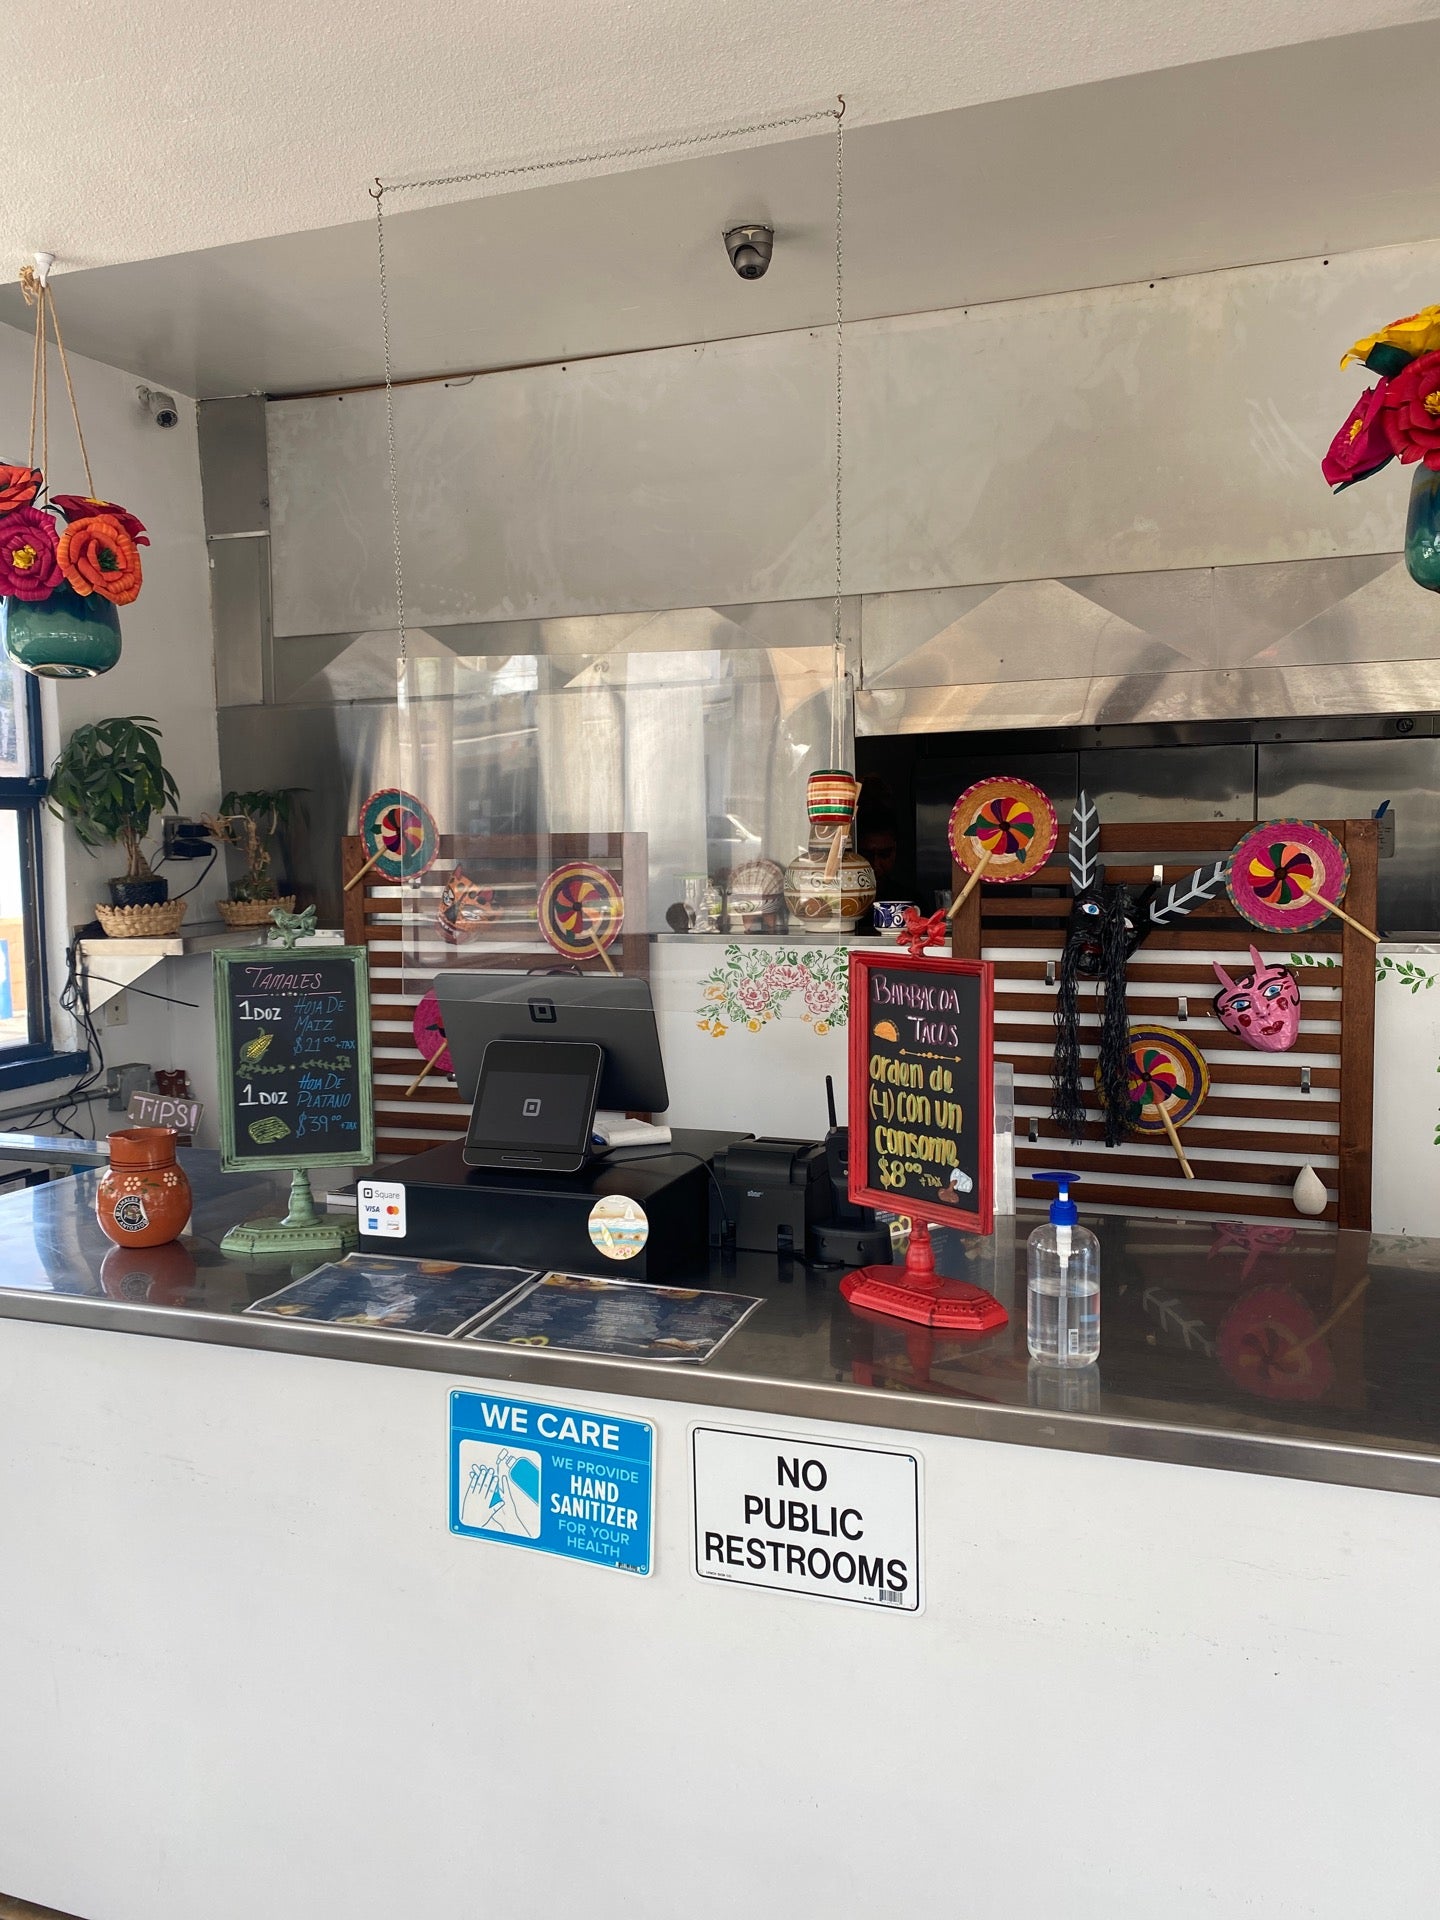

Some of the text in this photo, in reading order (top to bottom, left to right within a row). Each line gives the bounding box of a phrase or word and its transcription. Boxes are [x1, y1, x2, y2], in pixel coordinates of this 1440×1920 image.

[245, 966, 322, 989] TAMALES
[294, 996, 347, 1015] HOJA DE
[871, 974, 960, 1014] BARBACOA
[294, 1015, 333, 1036] MAIZ
[906, 1015, 959, 1047] TACOS
[298, 1072, 346, 1090] HOJA DE
[929, 1064, 954, 1094] de
[869, 1083, 895, 1123] (4)
[934, 1100, 963, 1134] un
[365, 1205, 380, 1213] VISA
[374, 1190, 401, 1199] Square
[481, 1402, 620, 1451] WE CARE
[551, 1455, 640, 1484] WE PROVIDE
[777, 1455, 828, 1492] NO
[570, 1474, 619, 1503] HAND
[550, 1493, 638, 1531] SANITIZER
[744, 1494, 864, 1541] PUBLIC
[558, 1519, 630, 1546] FOR YOUR
[567, 1535, 620, 1558] HEALTH
[704, 1530, 908, 1592] RESTROOMS
